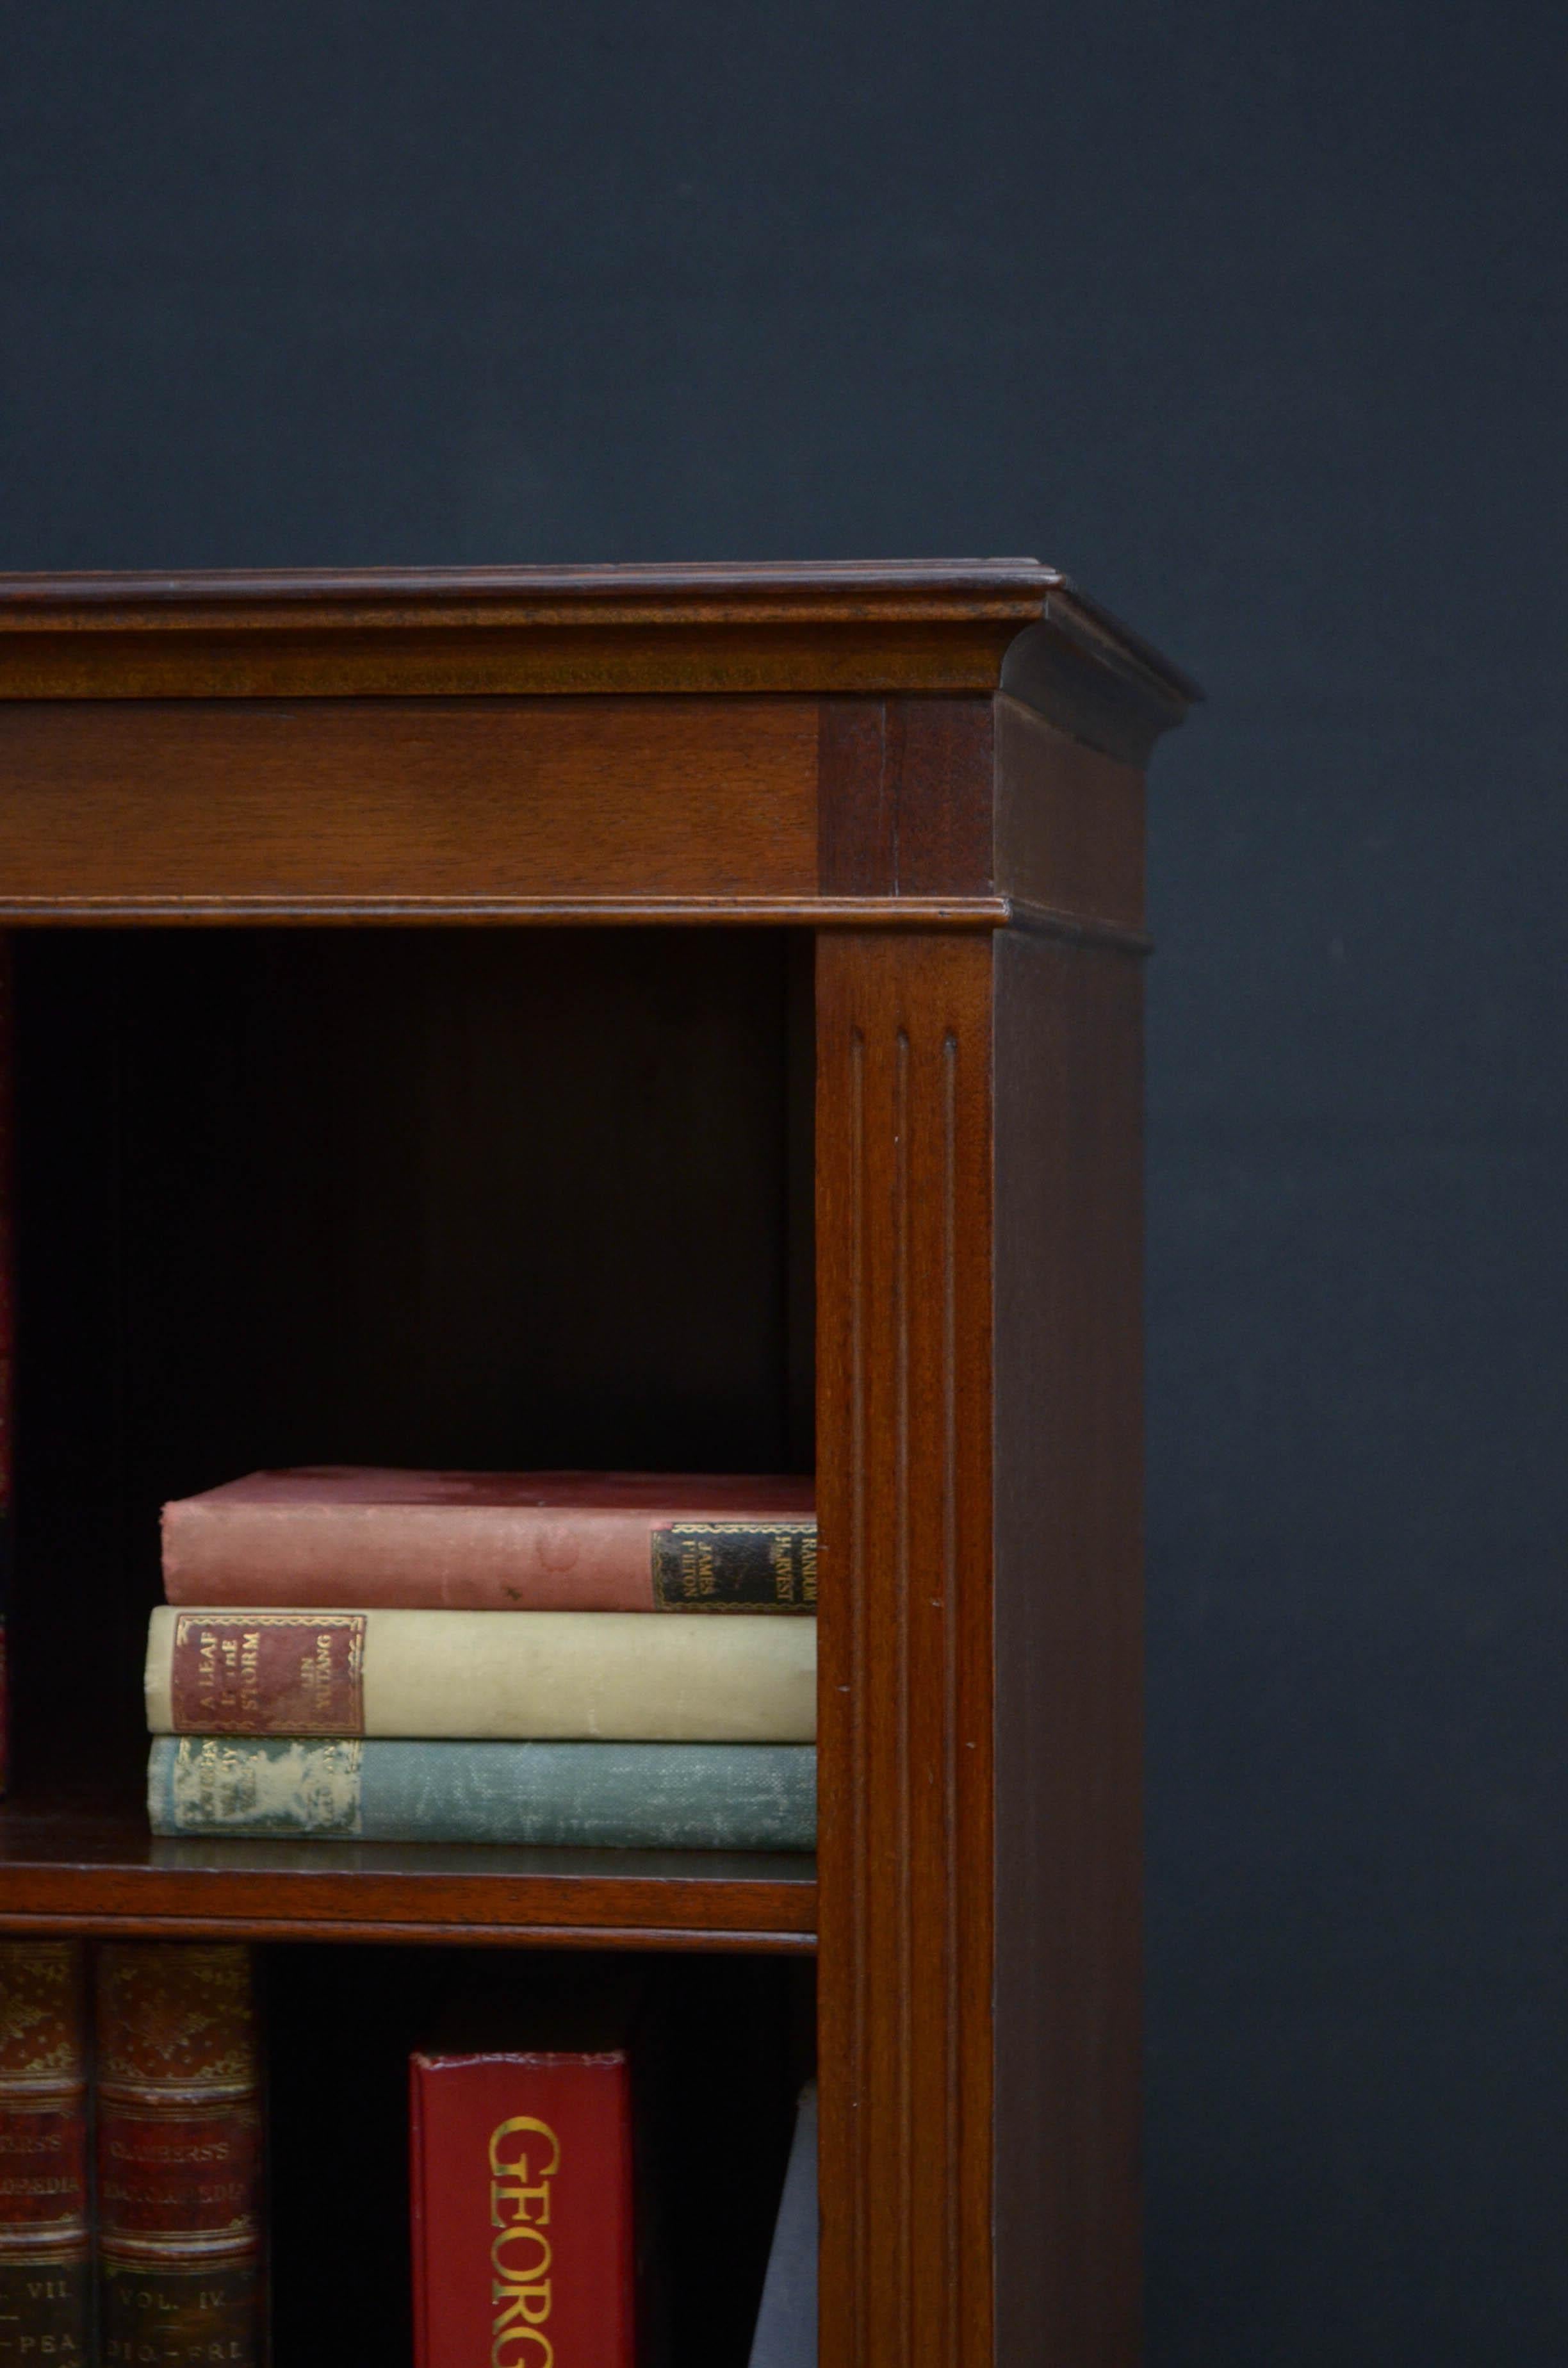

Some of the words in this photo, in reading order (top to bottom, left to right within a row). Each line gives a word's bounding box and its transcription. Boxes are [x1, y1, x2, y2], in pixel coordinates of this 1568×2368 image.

[698, 1542, 714, 1595] JAMES
[199, 1631, 218, 1688] LEAF
[240, 1632, 260, 1711] STORM
[301, 1657, 313, 1688] LIN
[315, 1635, 332, 1709] YUTANG
[200, 1695, 215, 1709] A
